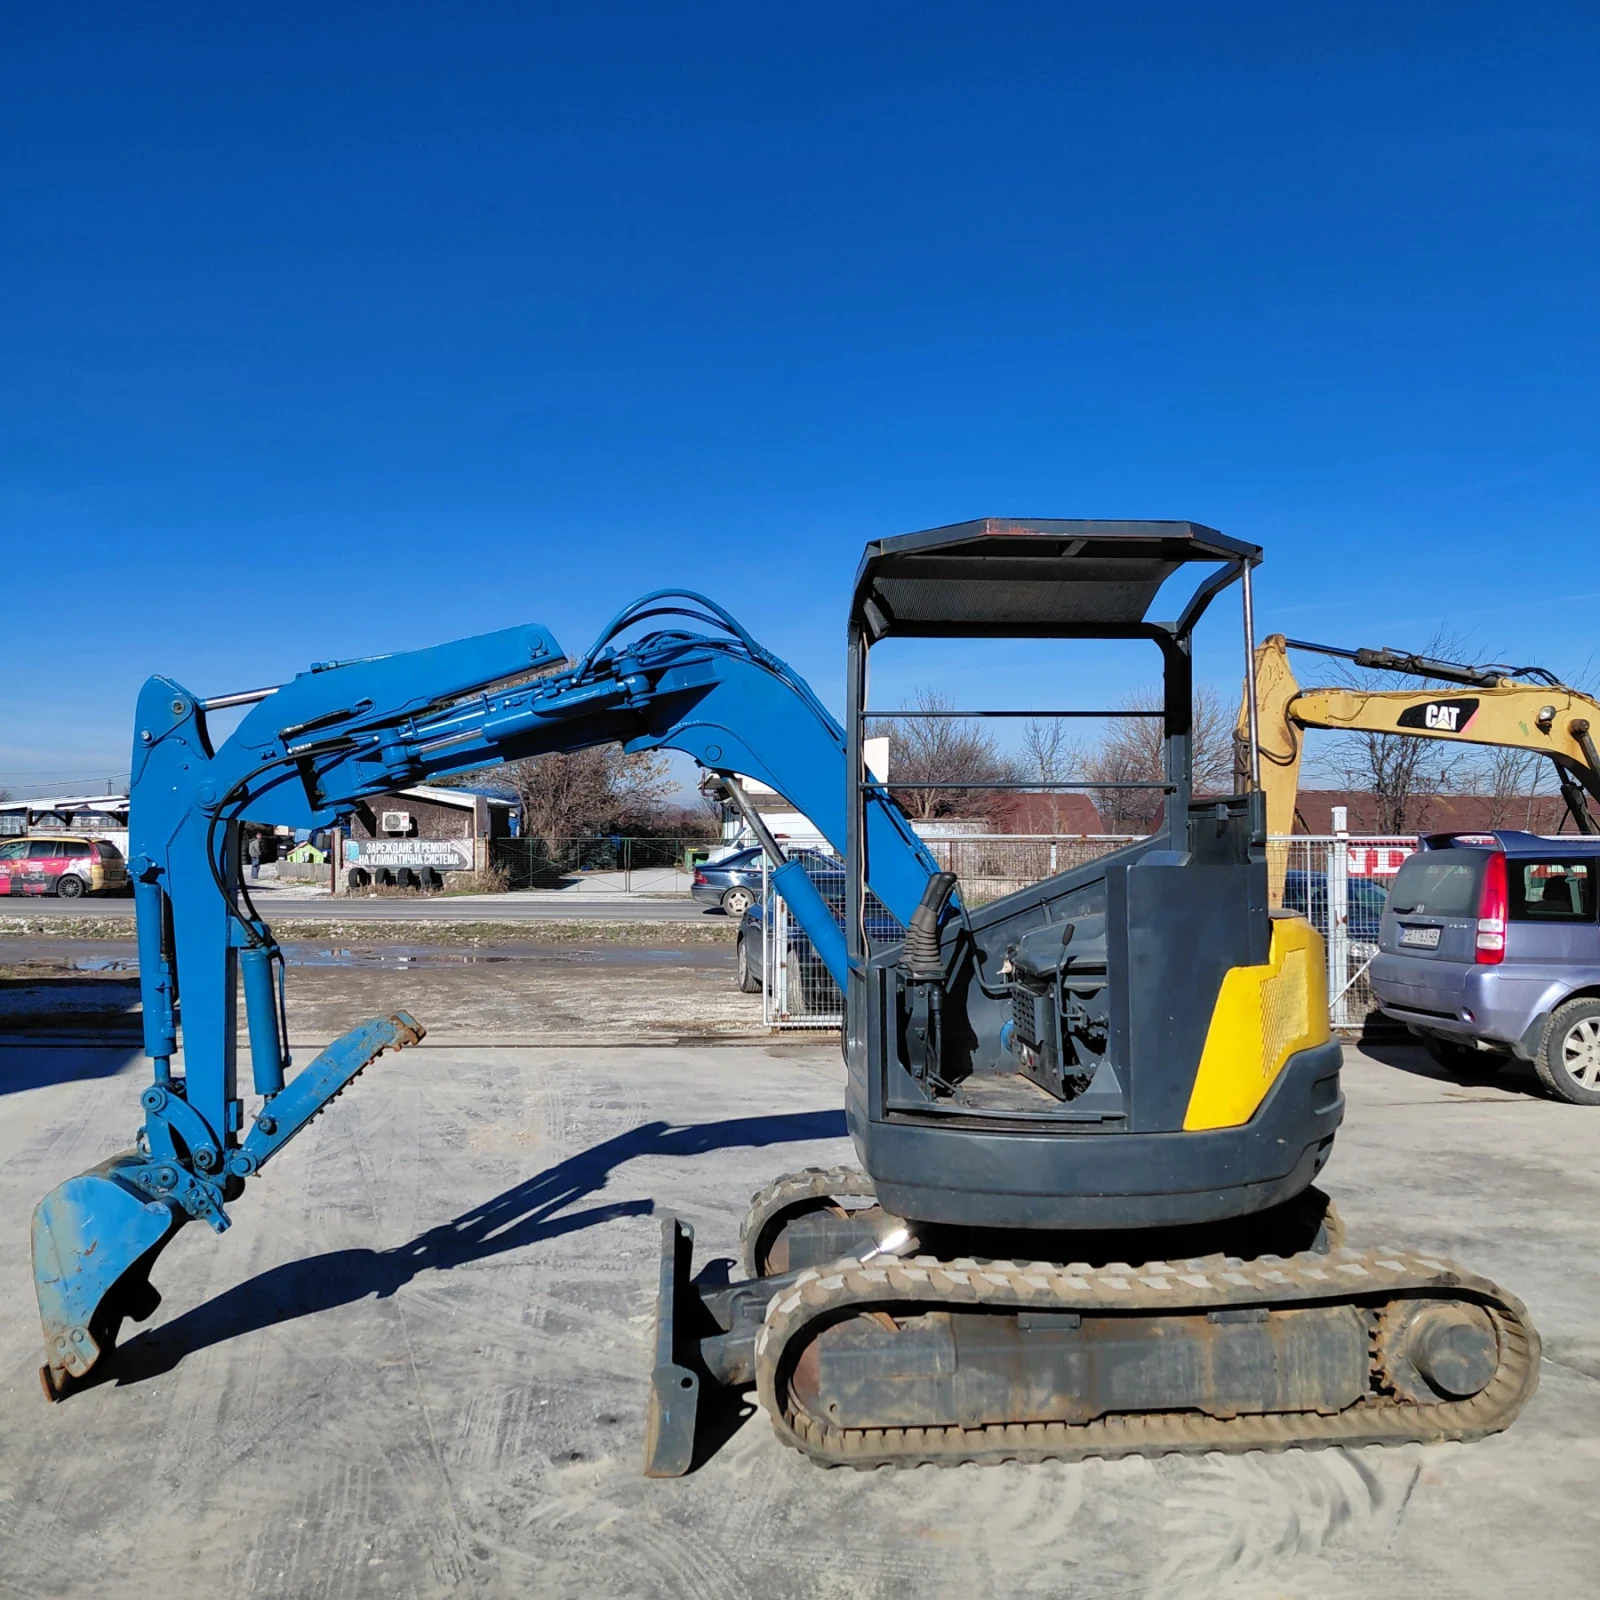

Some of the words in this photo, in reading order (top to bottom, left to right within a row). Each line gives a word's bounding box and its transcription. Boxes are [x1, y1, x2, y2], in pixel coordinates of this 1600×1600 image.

[1425, 704, 1460, 730] CAT
[366, 842, 413, 854] ЗАРЕЖДАНЕ
[414, 842, 420, 853] И
[421, 842, 451, 854] РЕМОНТ
[359, 854, 370, 865] НА
[371, 854, 423, 865] КЛИМАТИЧНА
[424, 854, 460, 865] СИСТЕМА
